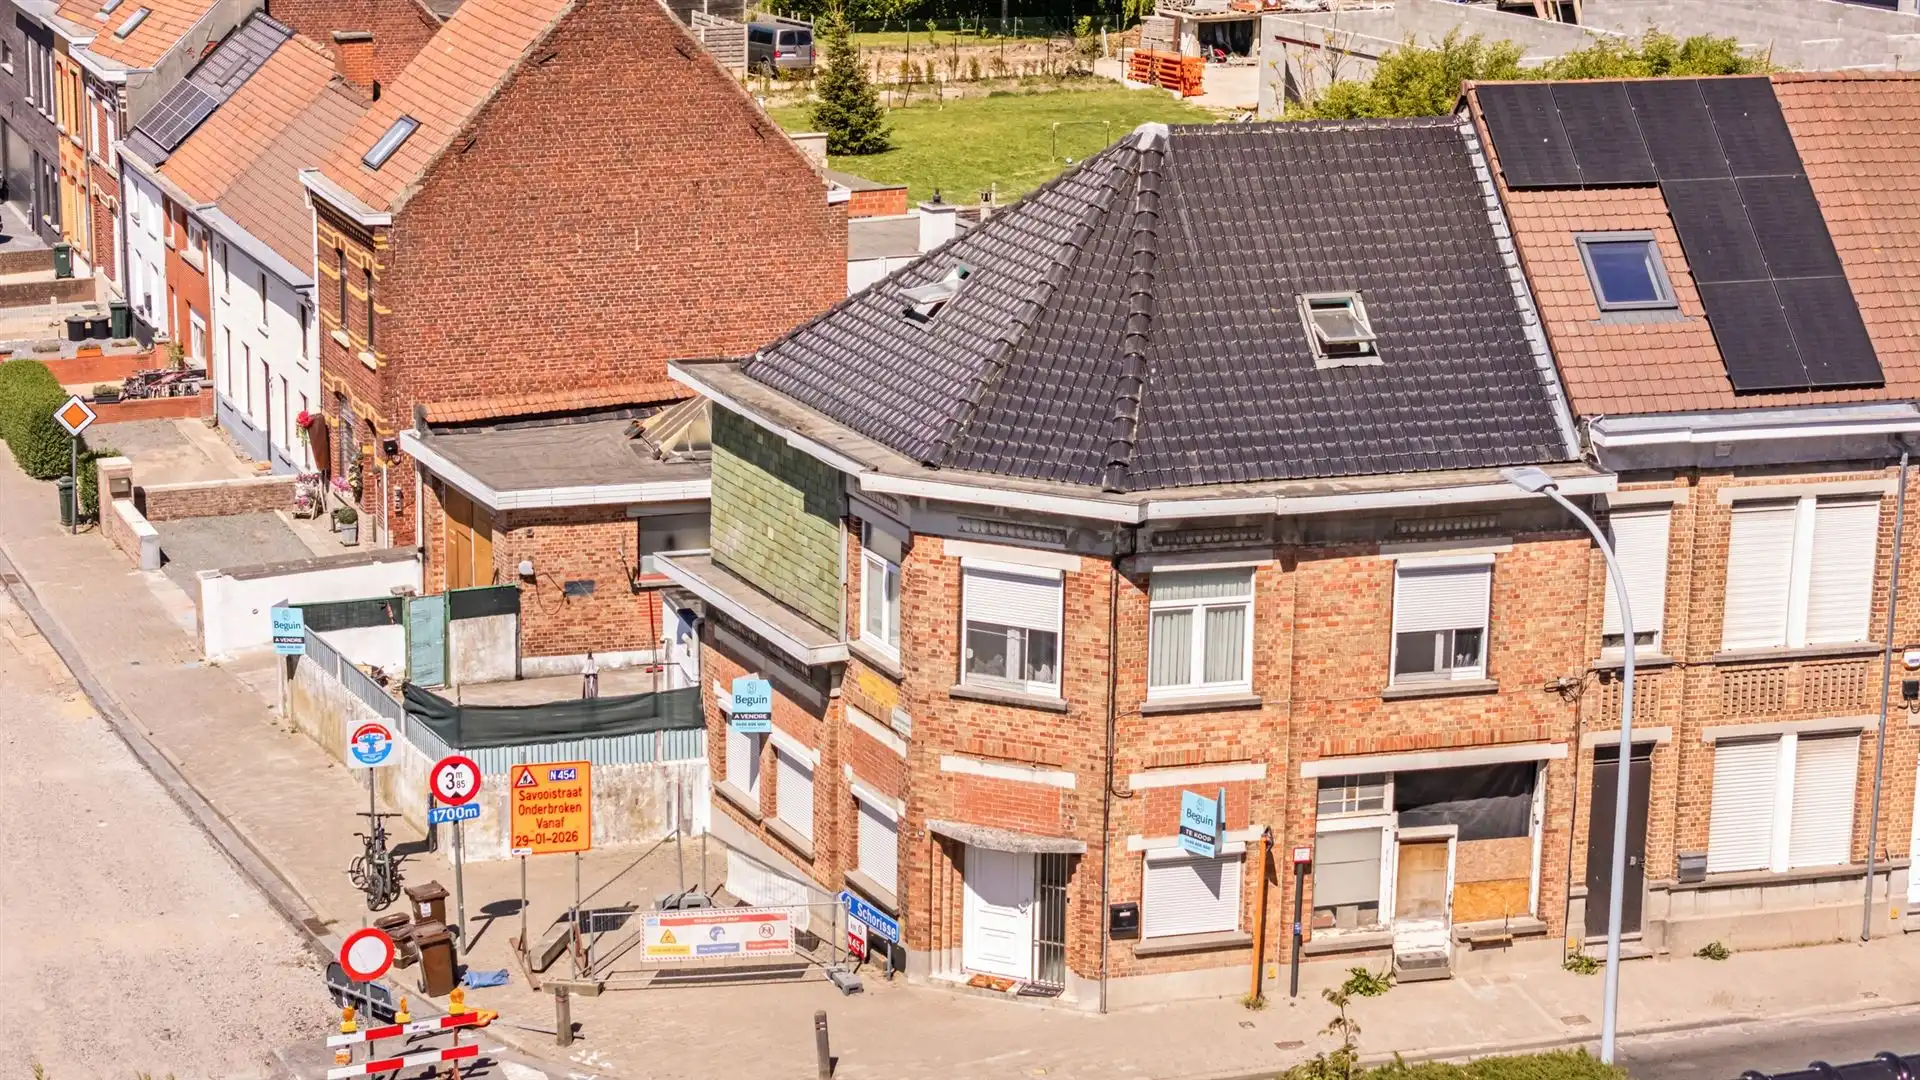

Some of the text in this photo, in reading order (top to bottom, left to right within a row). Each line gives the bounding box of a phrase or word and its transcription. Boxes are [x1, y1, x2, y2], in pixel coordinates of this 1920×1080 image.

[274, 621, 301, 632] Beguin
[735, 695, 768, 706] Beguin
[445, 772, 455, 790] 3
[550, 768, 576, 780] N 454
[456, 780, 466, 788] 85
[518, 786, 582, 801] Savooistraat
[432, 807, 477, 823] 1700m
[518, 802, 581, 816] Onderbroken
[536, 817, 565, 829] Vanaf
[1186, 808, 1214, 826] Beguin
[515, 831, 579, 847] 29-01-2026
[1185, 828, 1212, 842] TE KOOP
[857, 902, 896, 939] Schorisse
